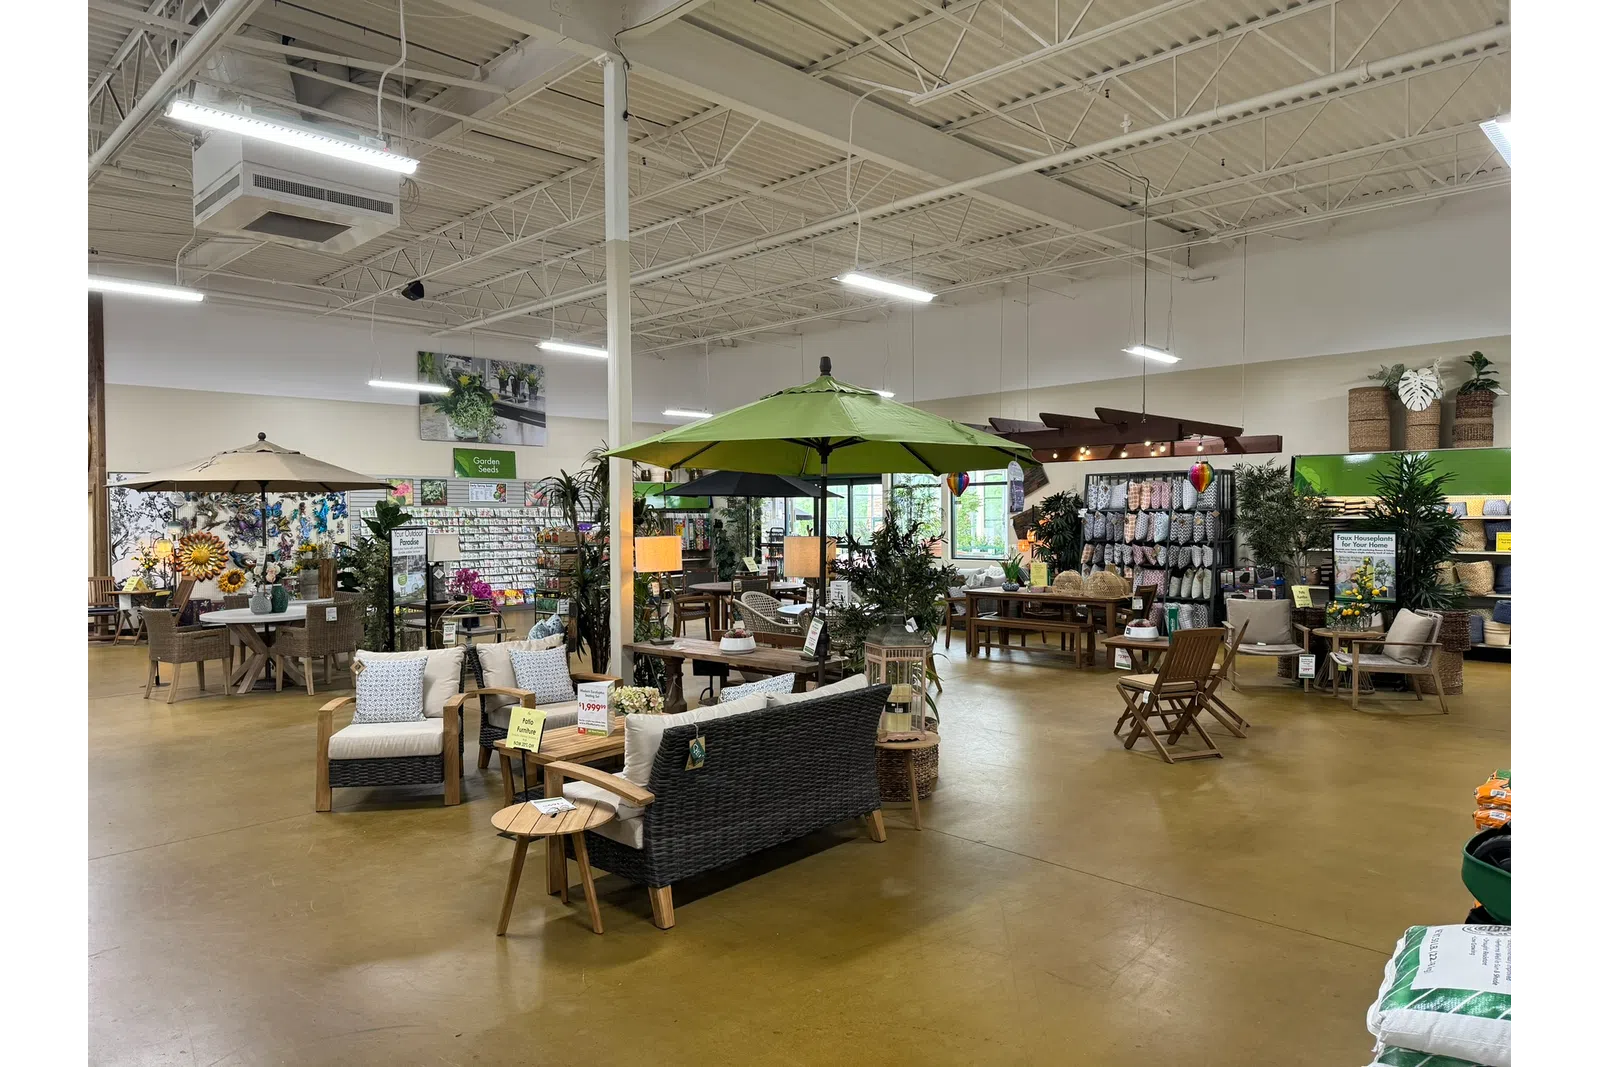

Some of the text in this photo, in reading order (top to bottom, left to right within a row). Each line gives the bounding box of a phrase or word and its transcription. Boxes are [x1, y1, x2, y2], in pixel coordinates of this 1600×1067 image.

[473, 456, 500, 465] Garden
[478, 464, 499, 473] Seeds
[400, 538, 419, 546] Paradise
[517, 726, 536, 735] Furniture
[1492, 974, 1500, 986] Shade
